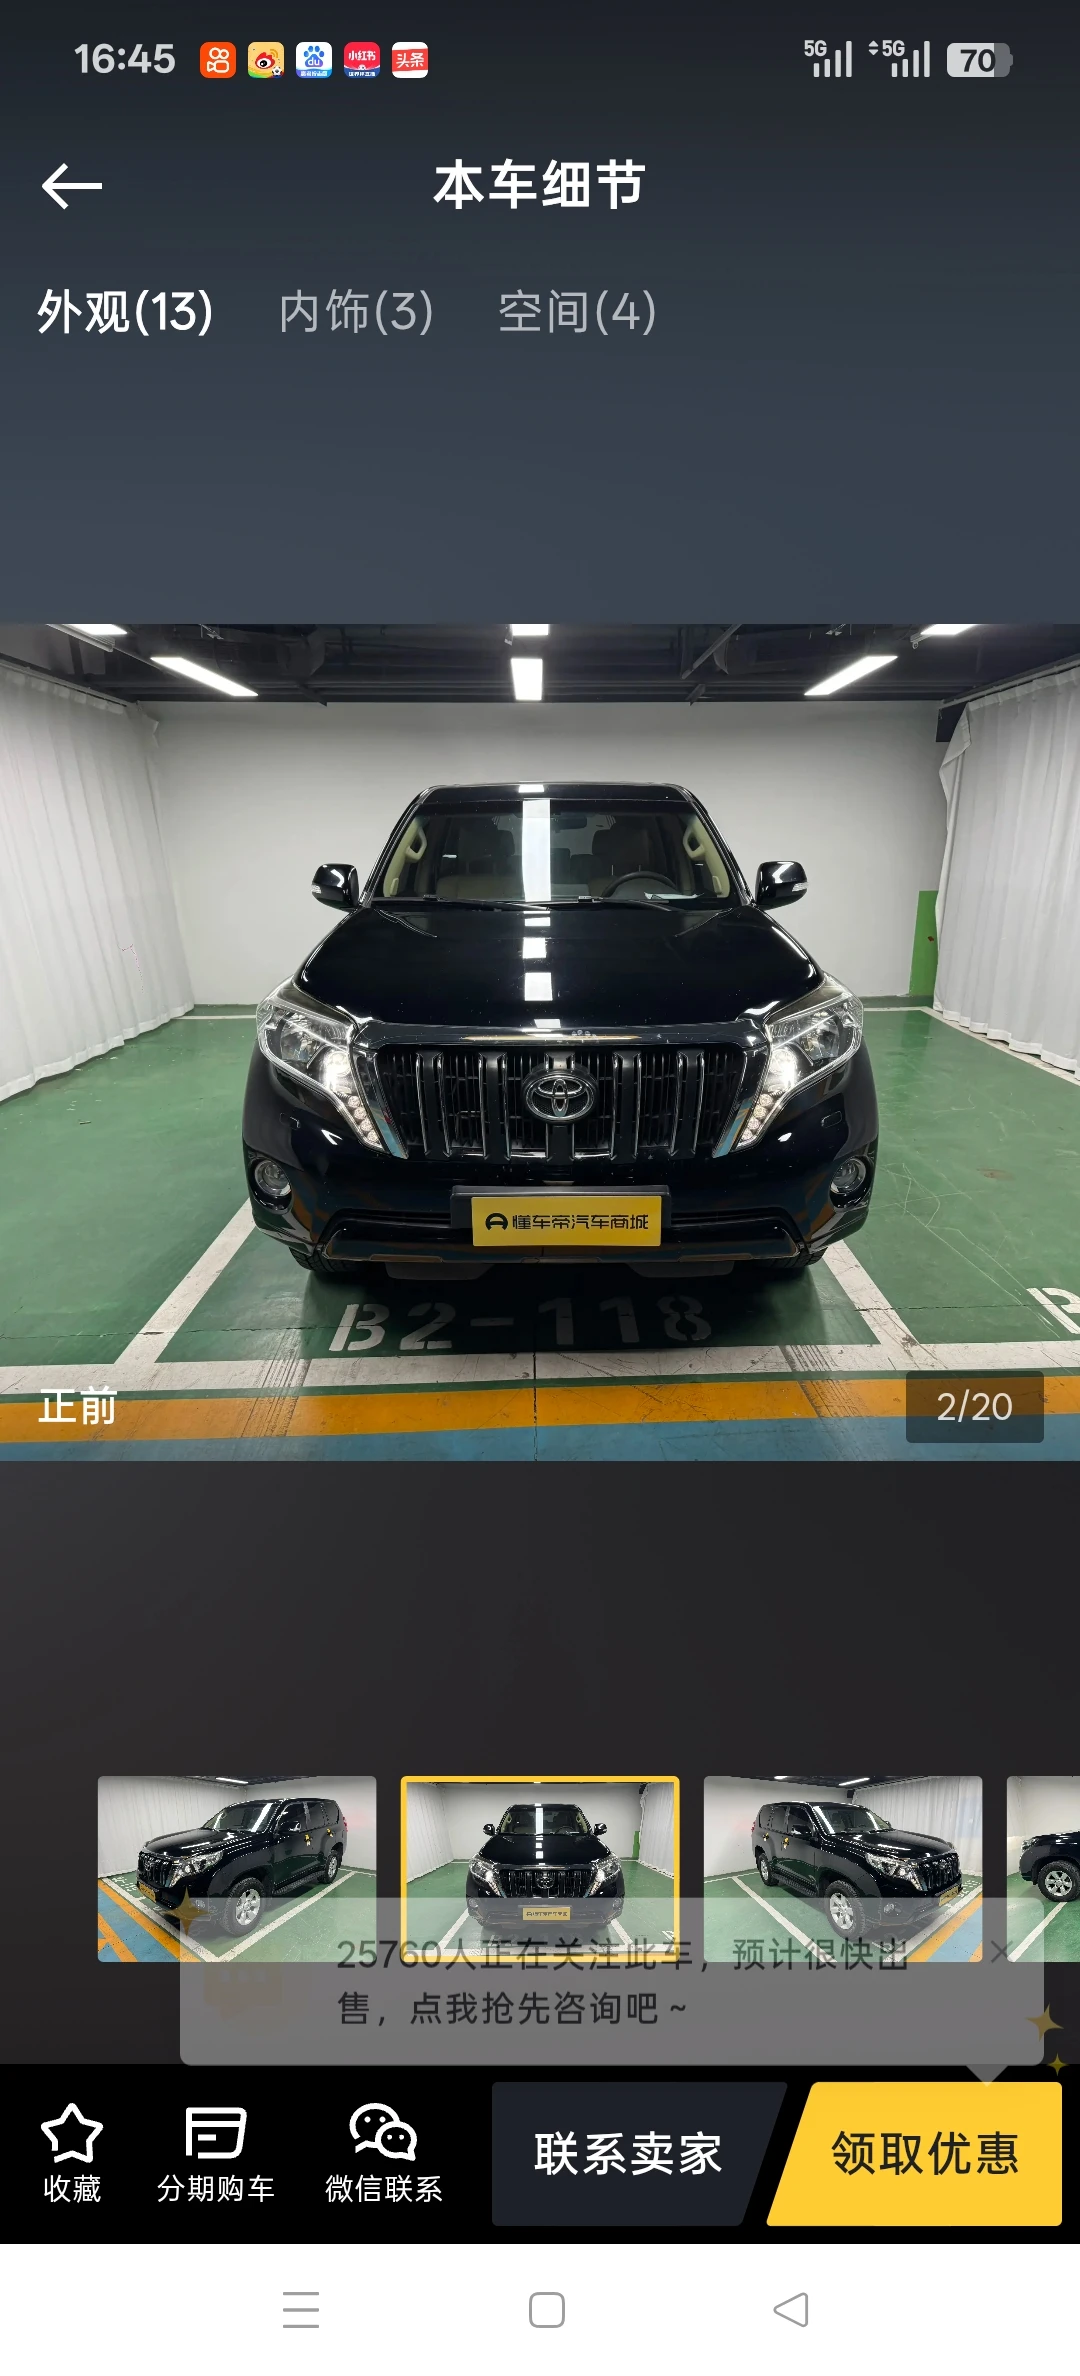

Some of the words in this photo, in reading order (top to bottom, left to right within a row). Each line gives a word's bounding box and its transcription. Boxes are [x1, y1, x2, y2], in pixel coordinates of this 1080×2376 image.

[74, 43, 176, 74] 16:45
[348, 49, 377, 62] 小红书
[395, 51, 426, 69] 头条
[804, 39, 828, 57] 5G
[881, 39, 906, 57] 5G
[959, 48, 997, 73] 70
[432, 157, 646, 210] 本车细节
[36, 288, 212, 337] 外观(13)
[280, 288, 434, 336] 内饰(3)
[498, 288, 656, 336] 空间(4)
[511, 1214, 649, 1231] 懂车帝汽车商城
[328, 1294, 712, 1352] B2-118
[533, 2130, 723, 2176] 联系卖家
[830, 2130, 1020, 2176] 领取优惠
[43, 2174, 102, 2204] 收藏
[156, 2174, 276, 2203] 分期购车
[324, 2174, 443, 2203] 微信联系
